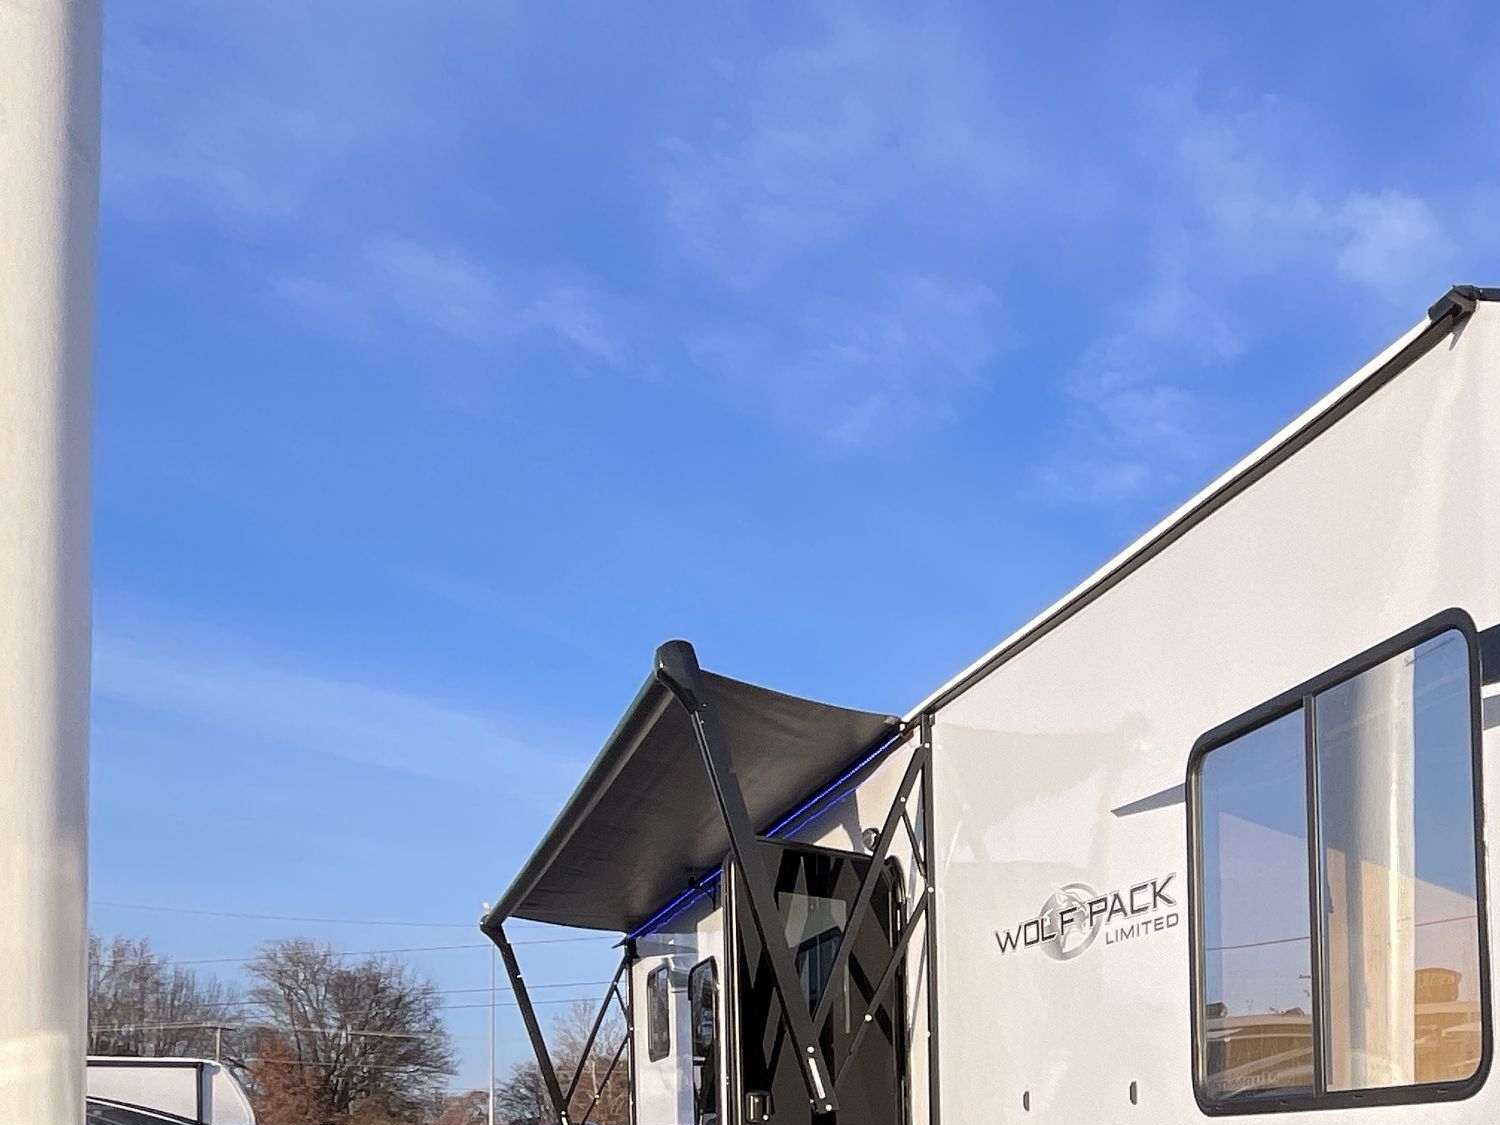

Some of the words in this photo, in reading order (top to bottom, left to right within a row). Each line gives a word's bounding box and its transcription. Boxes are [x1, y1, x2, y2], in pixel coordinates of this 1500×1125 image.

[995, 907, 1078, 954] WOLF
[1087, 872, 1177, 927] PACK
[1105, 912, 1179, 945] LIMITED
